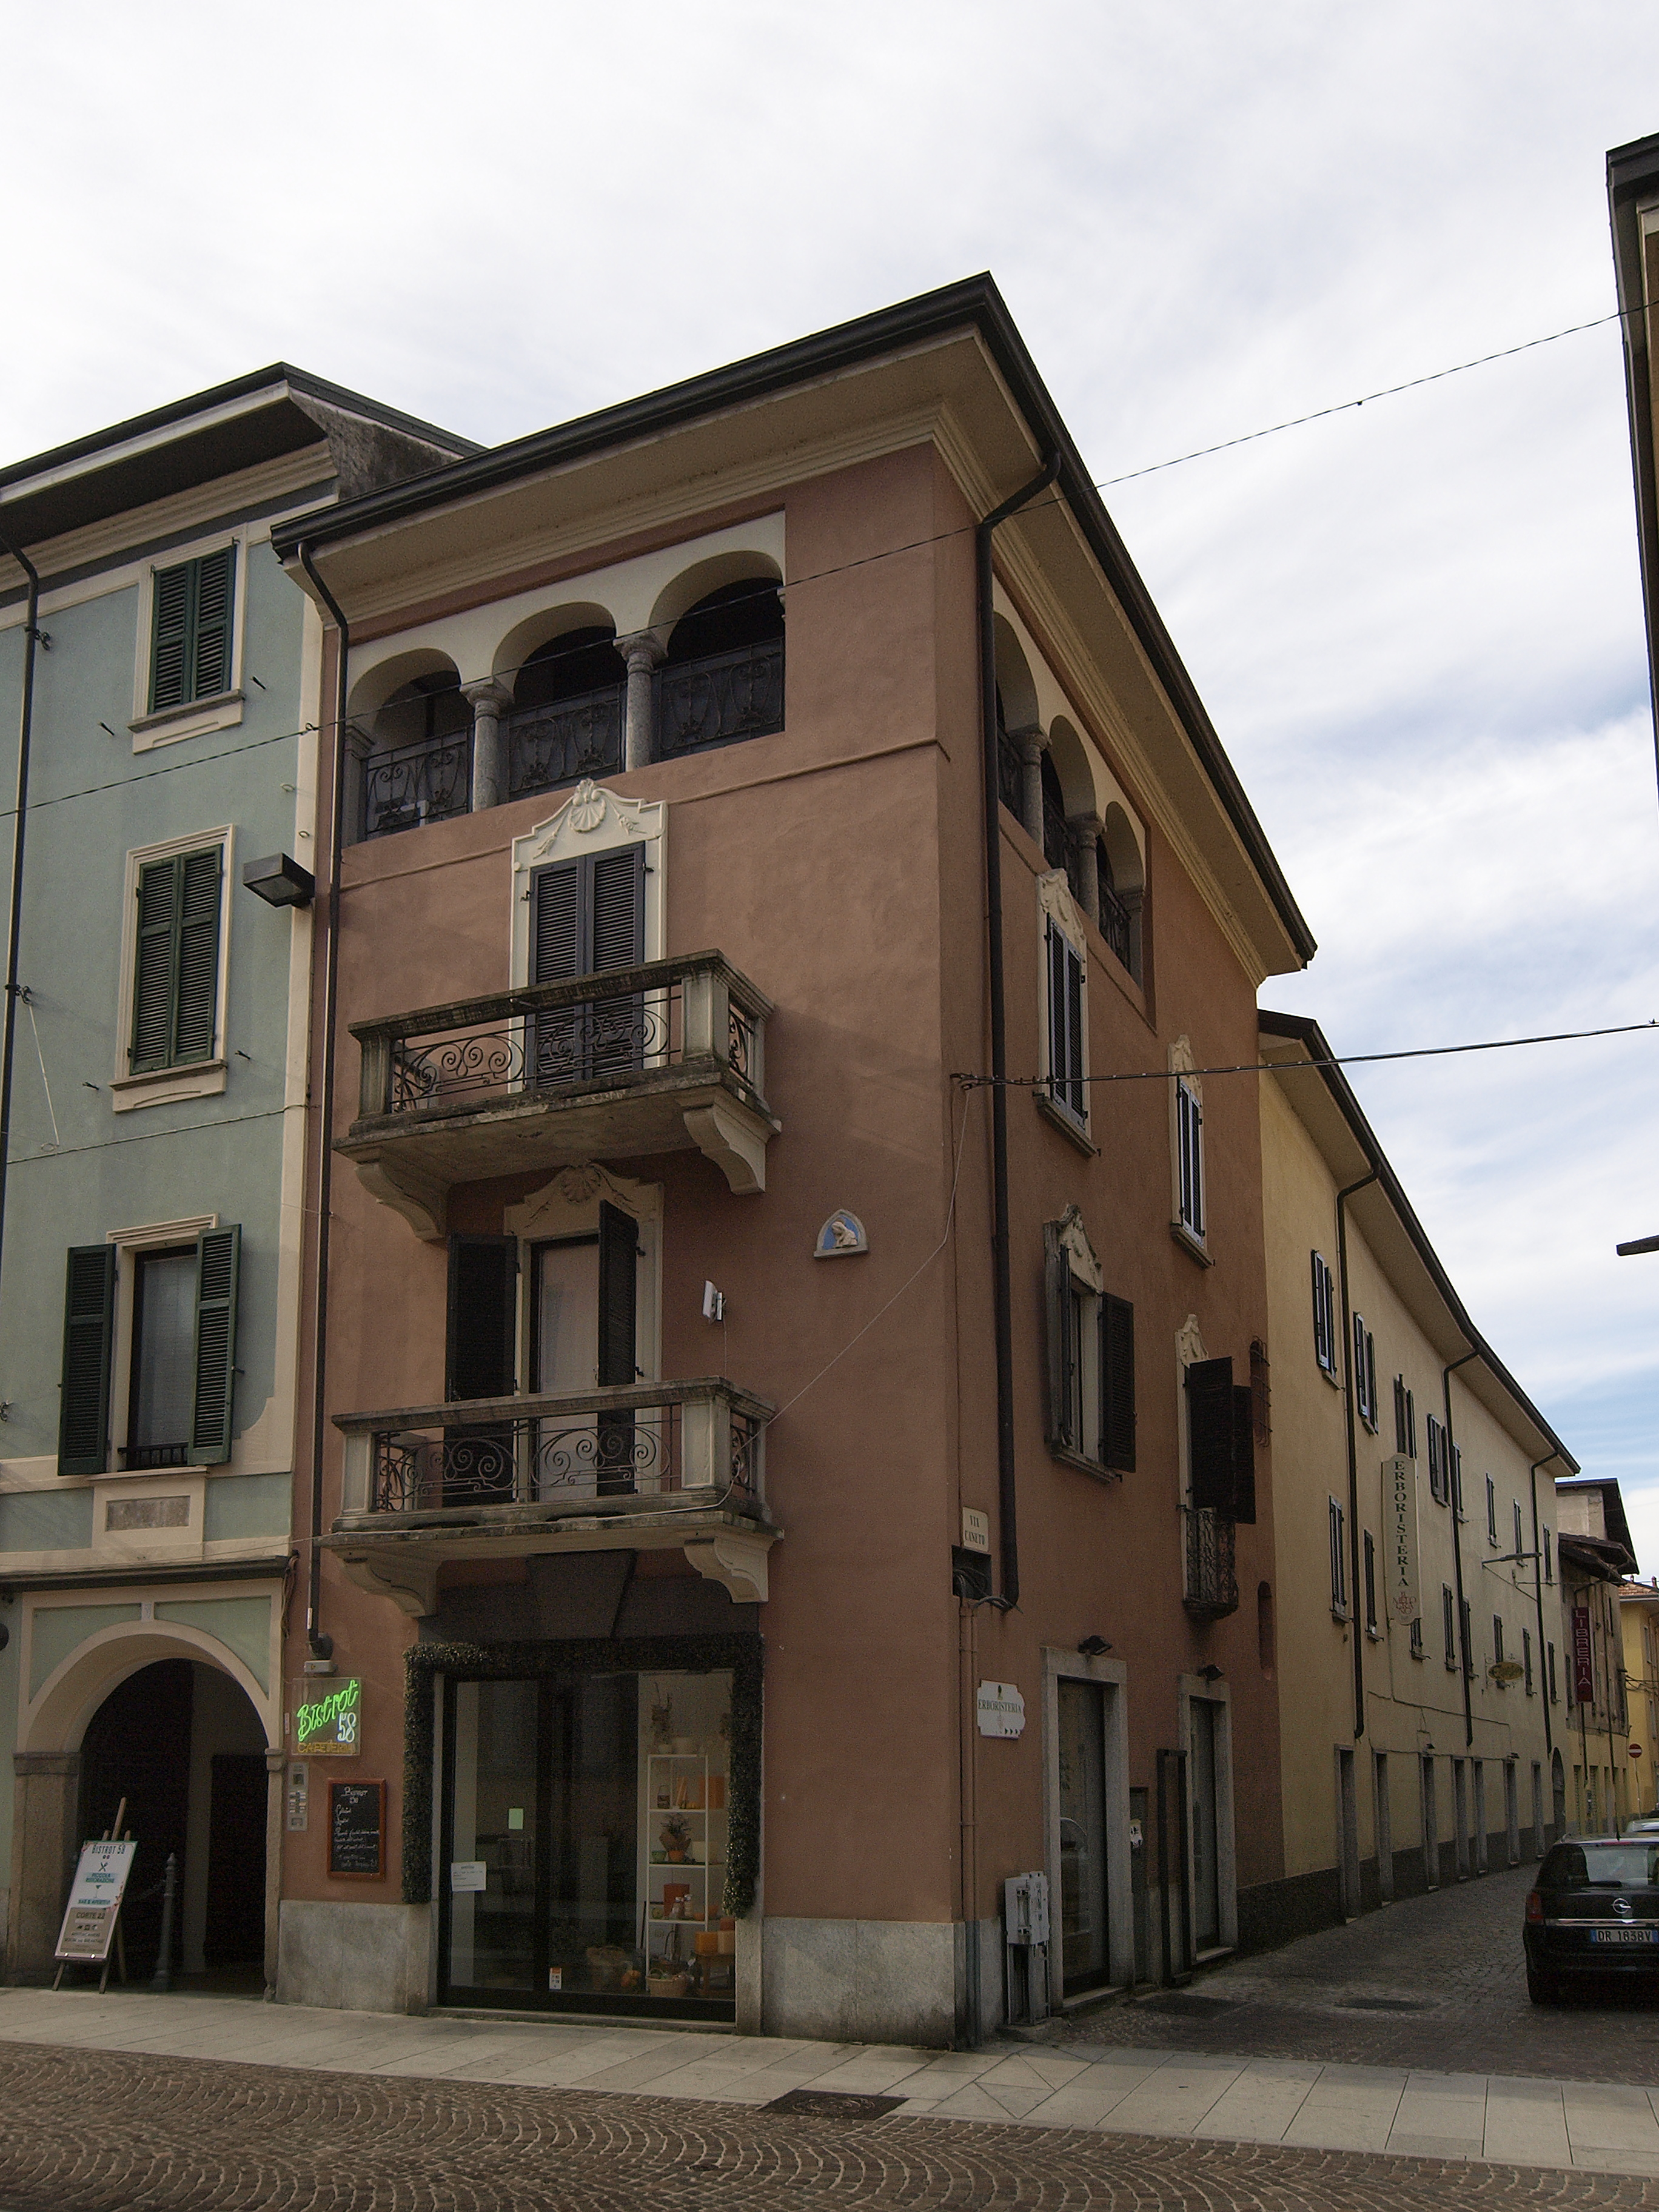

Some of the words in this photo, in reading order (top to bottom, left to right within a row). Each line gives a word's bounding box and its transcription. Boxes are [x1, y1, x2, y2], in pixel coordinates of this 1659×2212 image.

[970, 1515, 979, 1527] VIA
[1394, 1461, 1409, 1586] ERBORISTERIA
[1575, 1610, 1591, 1686] LIBRERIA
[297, 1679, 359, 1742] Bistrot
[977, 1698, 1022, 1714] ERBORISTERIA
[337, 1712, 357, 1743] 58
[92, 1845, 116, 1854] BISTROT
[117, 1844, 126, 1854] 58
[1598, 1930, 1611, 1942] DR
